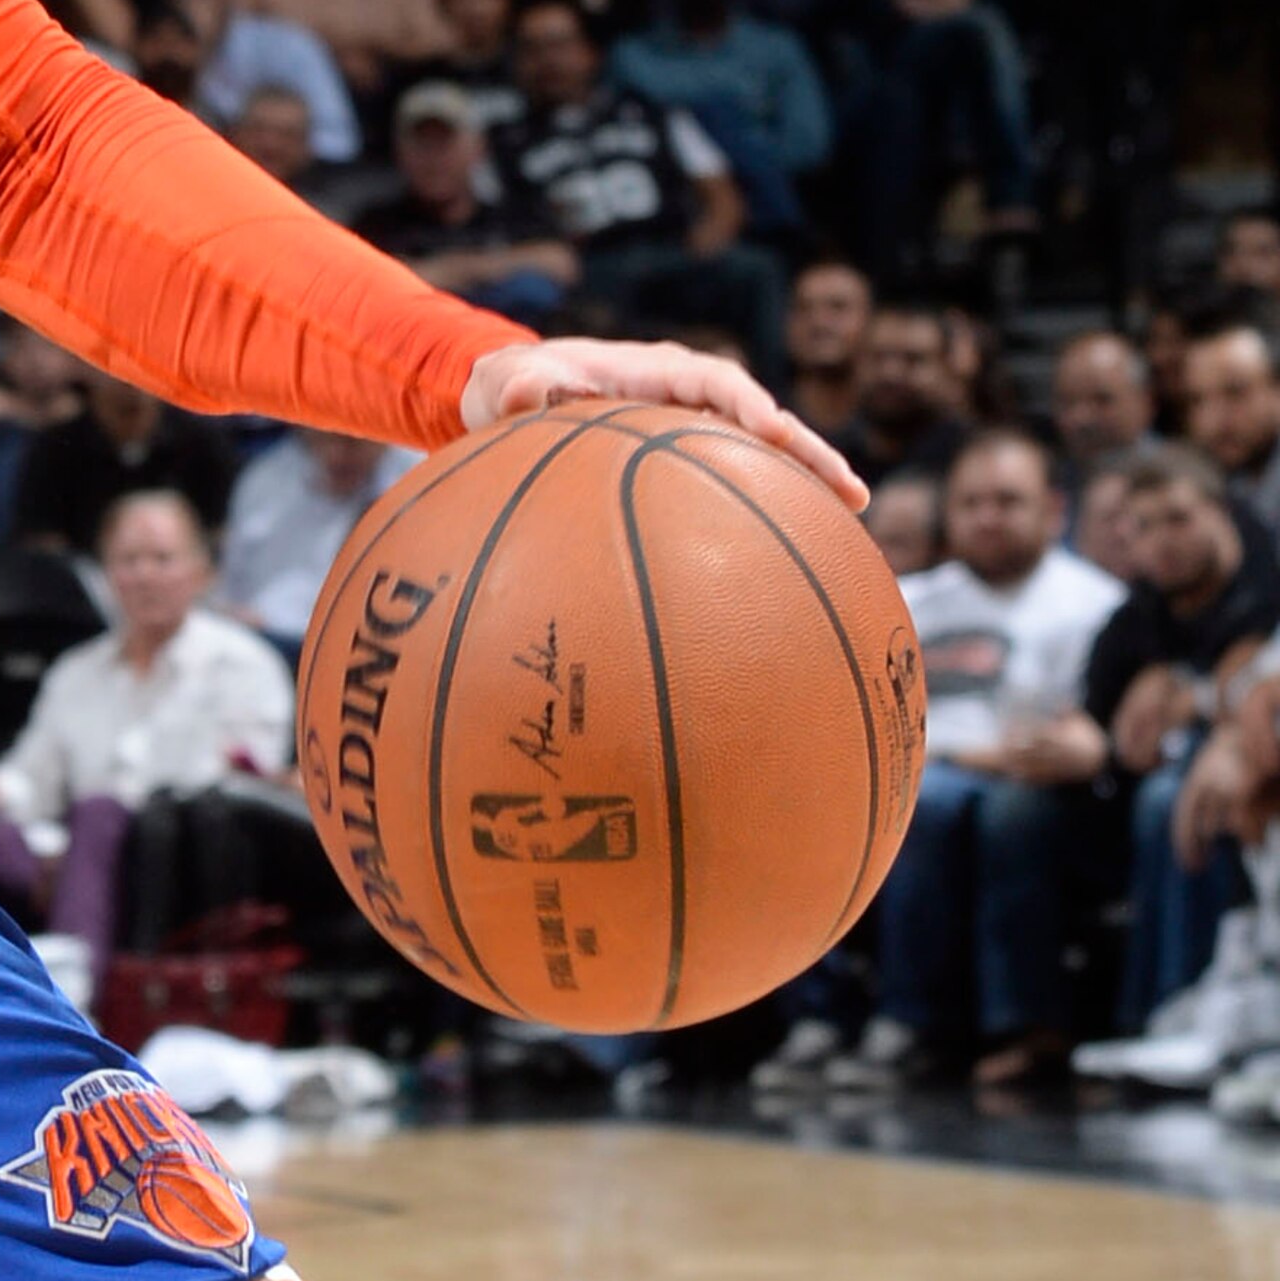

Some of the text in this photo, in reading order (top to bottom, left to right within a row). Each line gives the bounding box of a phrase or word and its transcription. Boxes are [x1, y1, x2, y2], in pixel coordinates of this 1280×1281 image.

[339, 570, 462, 978] SPALDING
[43, 1089, 232, 1223] KNIC
[70, 1077, 107, 1111] NEW
